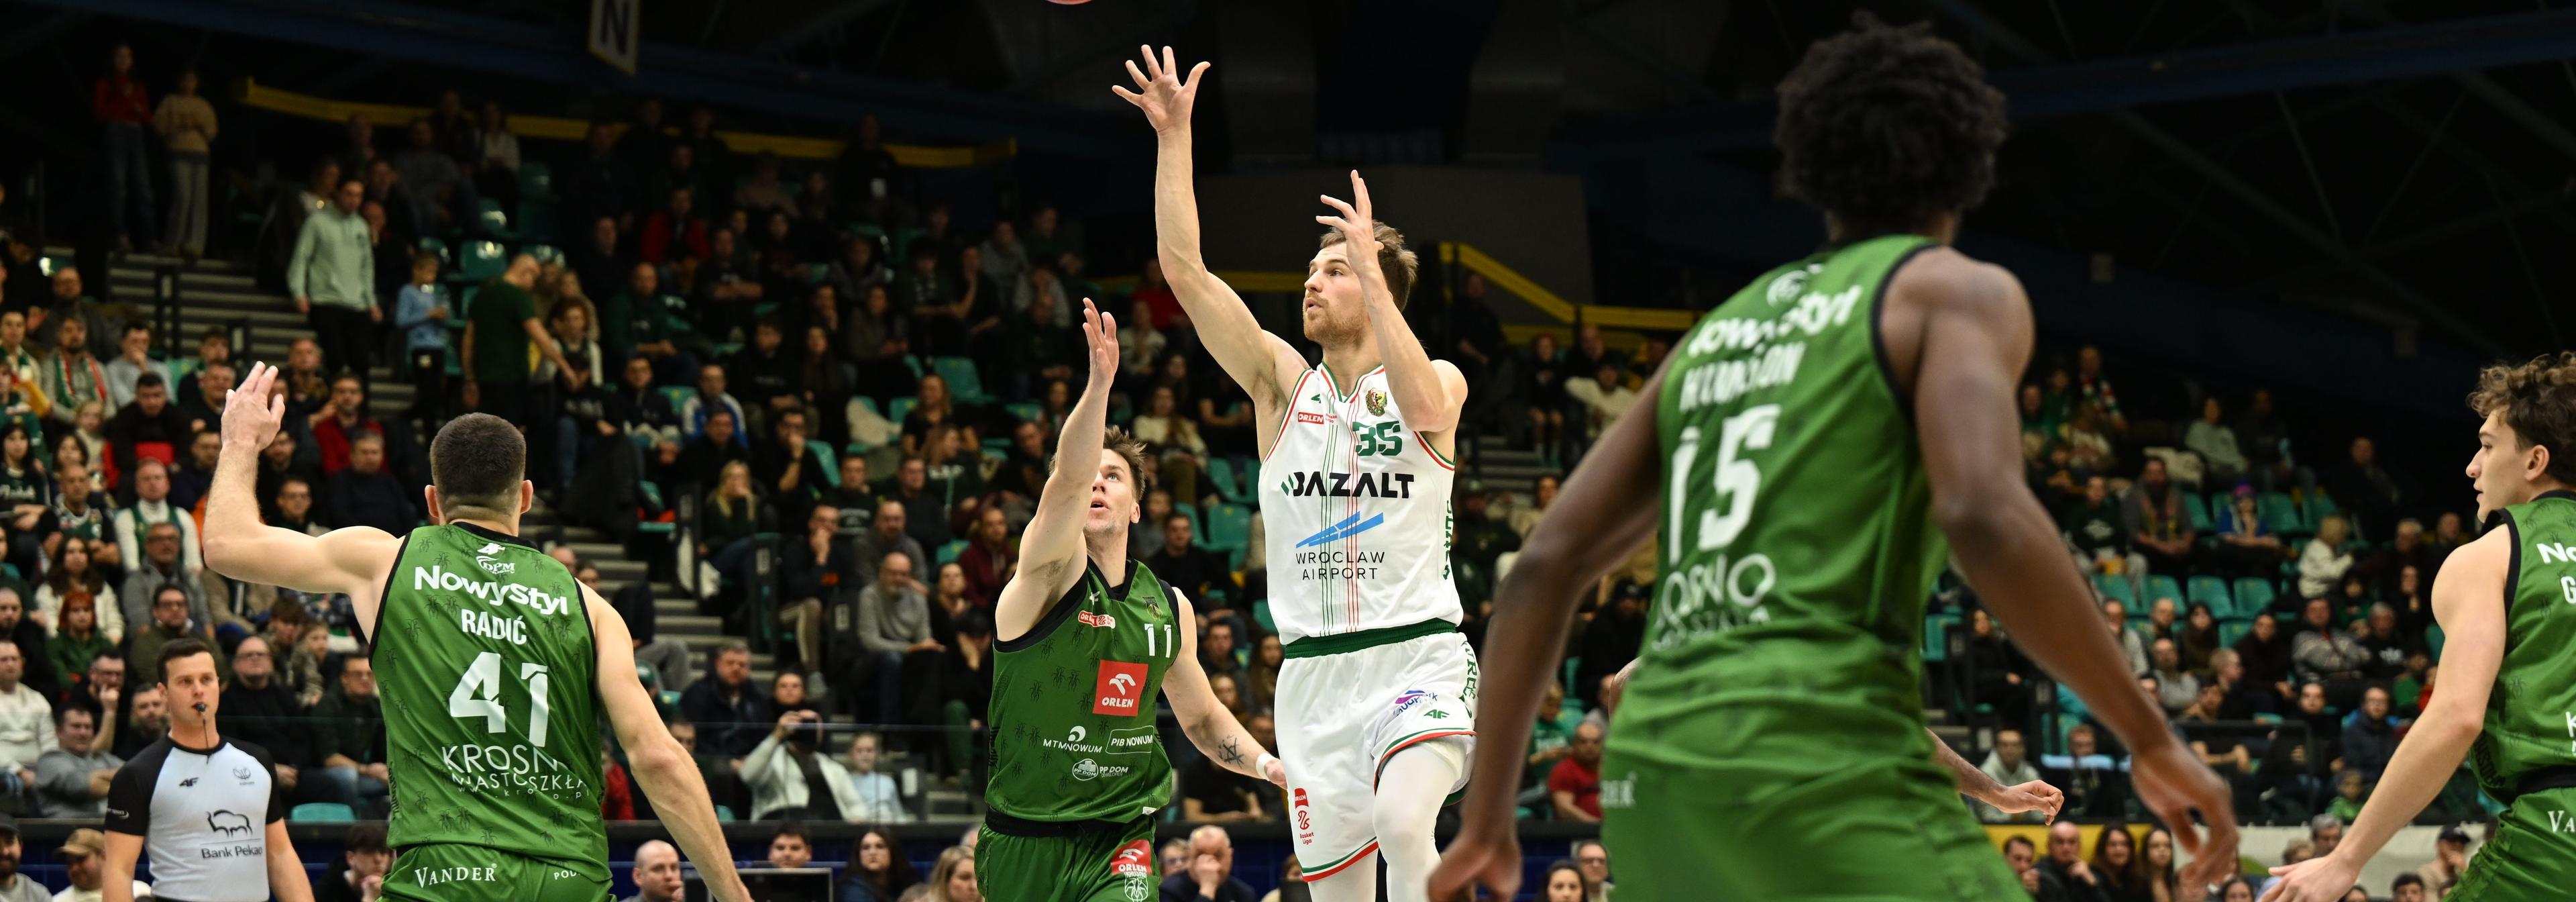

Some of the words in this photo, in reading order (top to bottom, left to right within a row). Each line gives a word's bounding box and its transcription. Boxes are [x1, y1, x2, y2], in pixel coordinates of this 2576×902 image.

[1298, 413, 1324, 423] ORLEN
[1352, 421, 1403, 456] 35
[1293, 471, 1414, 499] BAZALT
[1668, 403, 1781, 566] 15
[482, 562, 515, 571] DPM
[1295, 551, 1385, 564] WROCLAW
[1302, 567, 1378, 581] AIRPORT
[415, 565, 569, 615] NowyStyl
[461, 609, 527, 645] RADIĆ
[1144, 623, 1172, 658] 11
[449, 651, 549, 747] 41
[1102, 697, 1134, 708] ORLEN
[1111, 738, 1125, 746] PIB
[1126, 734, 1153, 747] NOWUM
[442, 744, 568, 774] KROSN
[201, 847, 232, 860] Bank
[235, 845, 262, 857] Pekao
[1118, 863, 1147, 872] ORLEN
